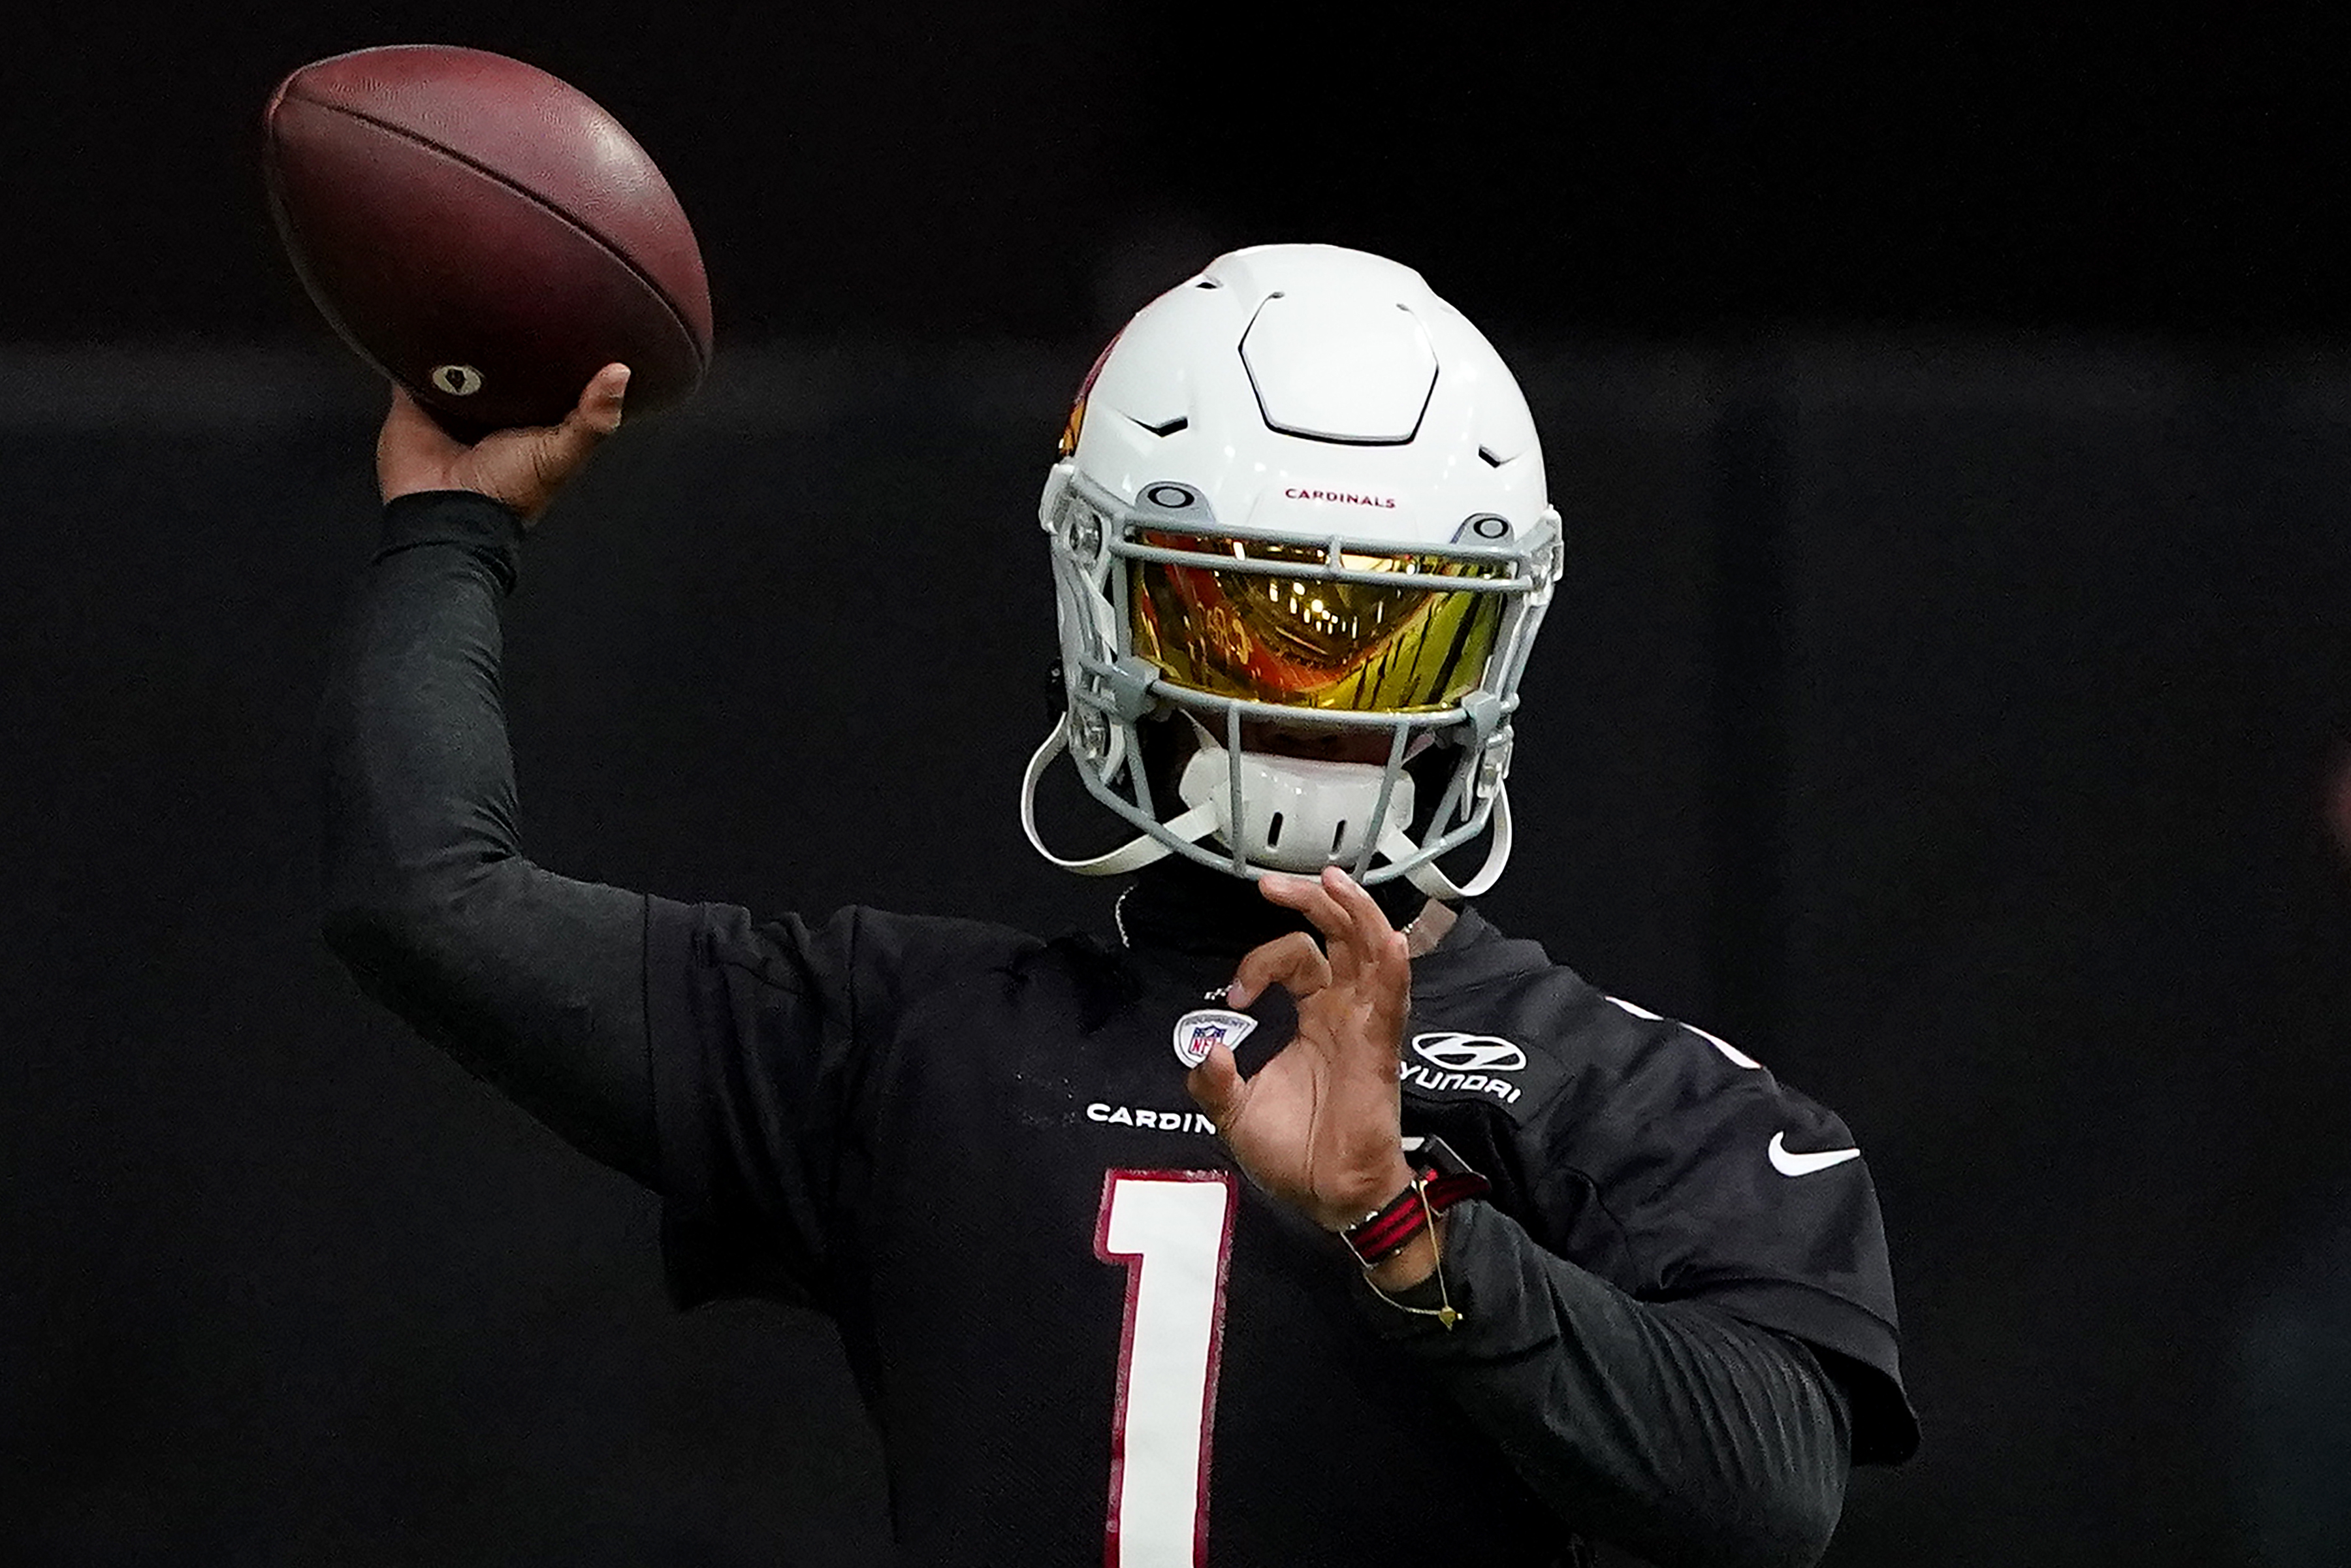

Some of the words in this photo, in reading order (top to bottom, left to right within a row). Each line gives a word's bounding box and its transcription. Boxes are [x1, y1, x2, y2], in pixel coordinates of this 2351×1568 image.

[1285, 488, 1396, 509] CARDINALS
[1192, 1037, 1215, 1055] NF
[1400, 1061, 1522, 1104] YUNDAI
[1087, 1103, 1216, 1135] CARDIN
[1093, 1168, 1239, 1568] 1
